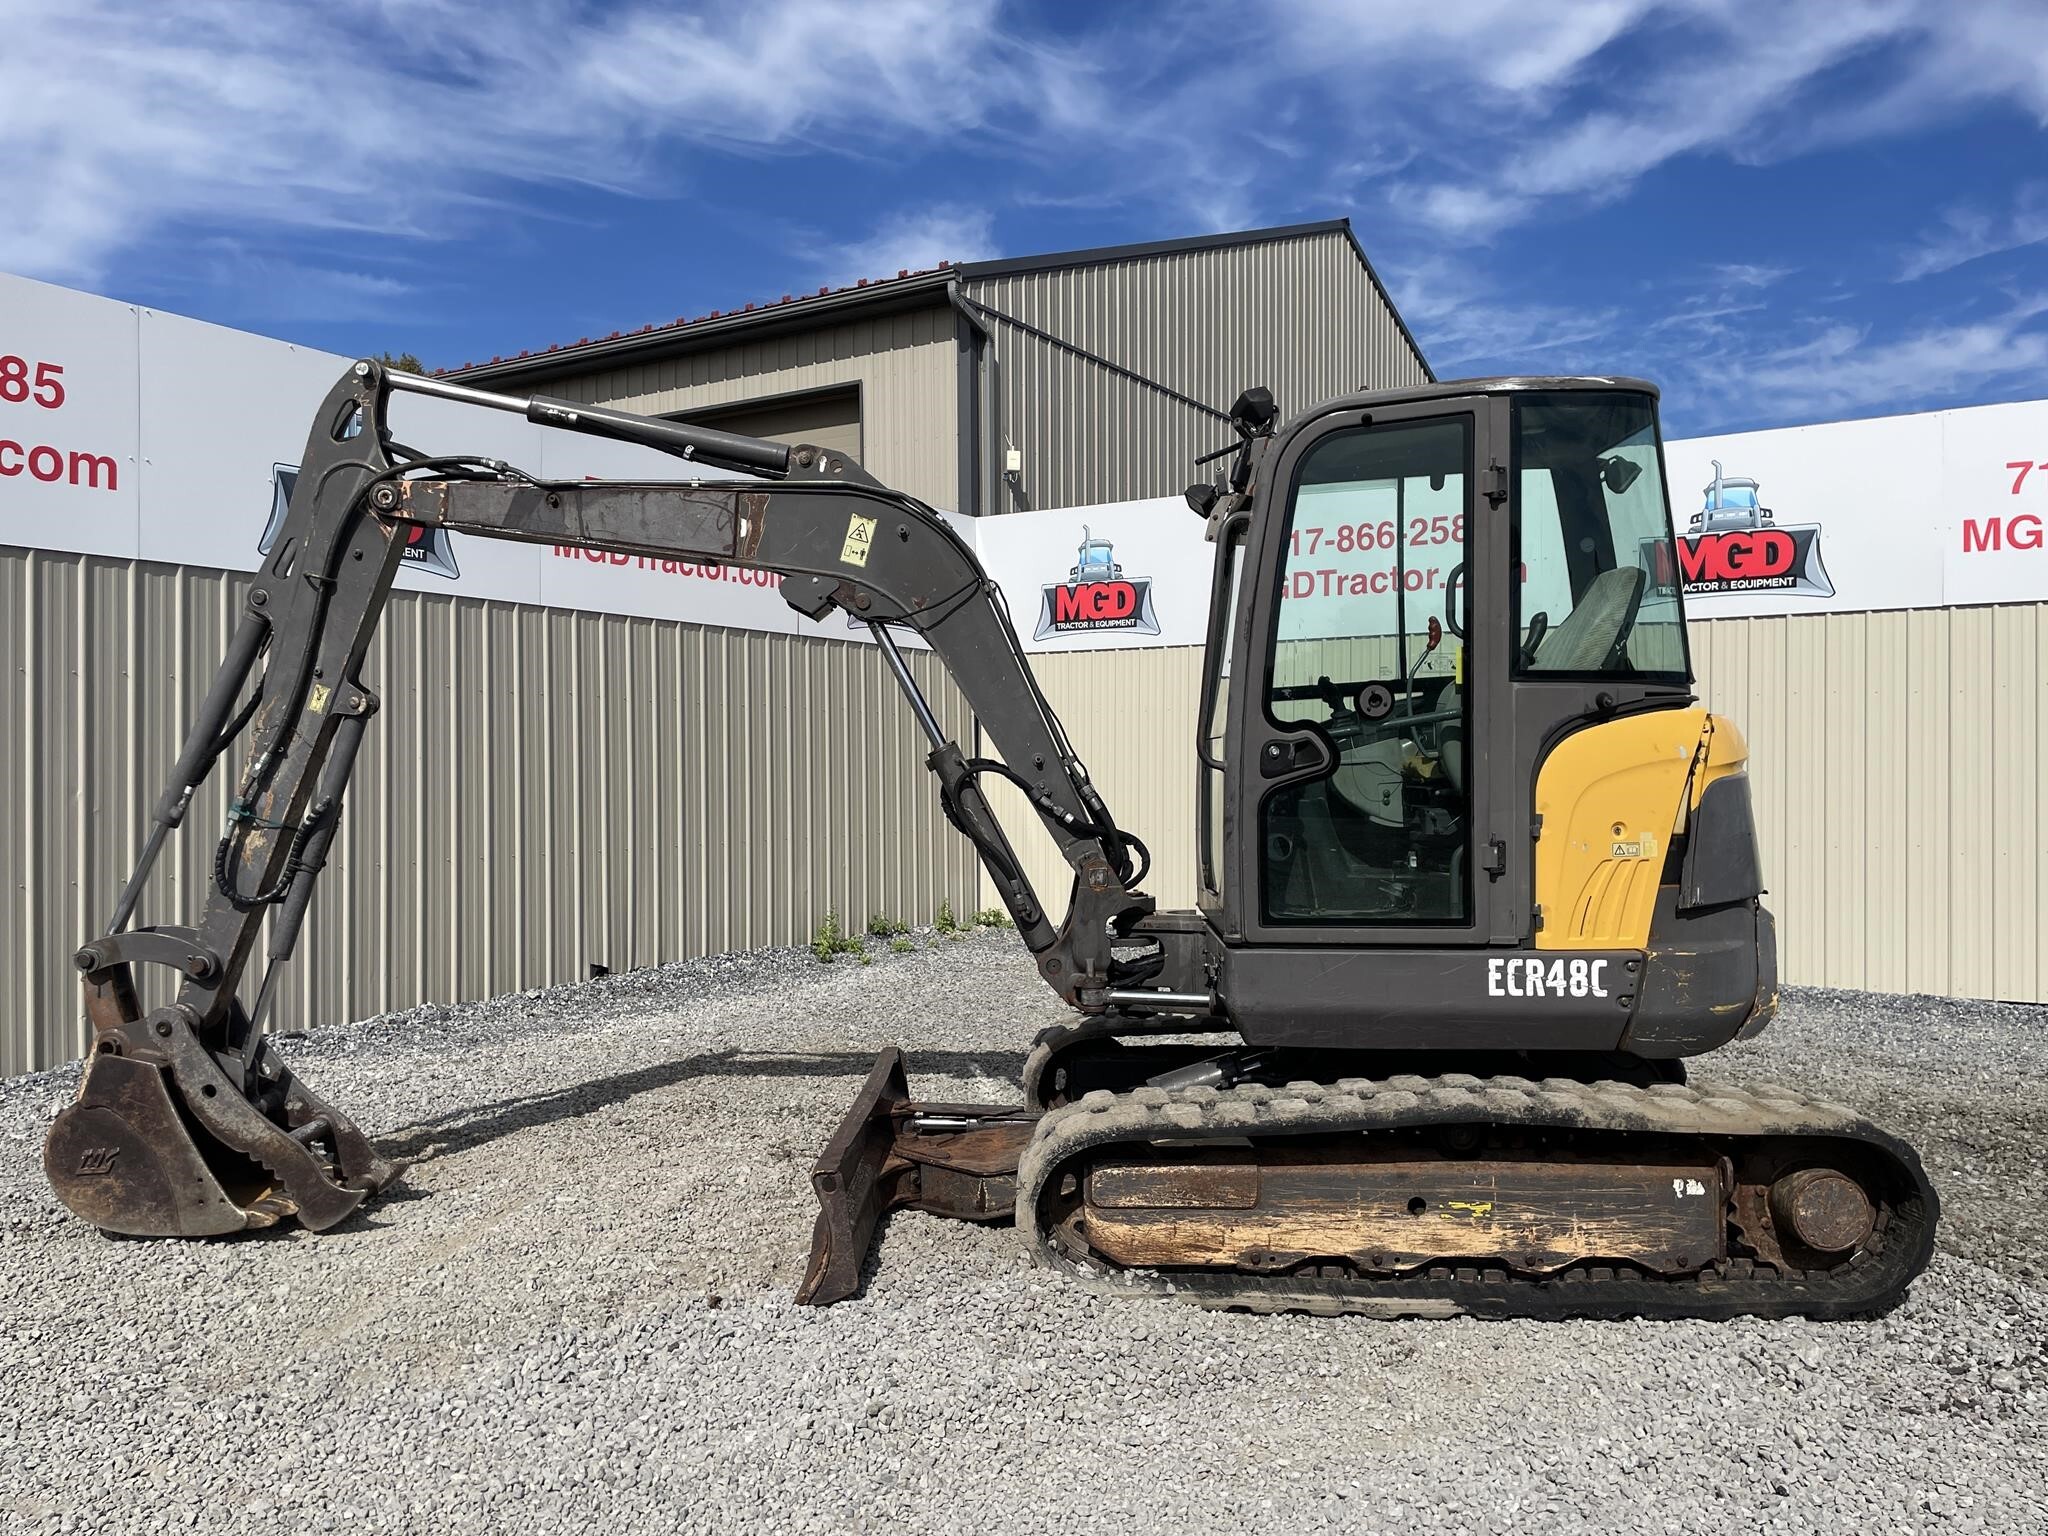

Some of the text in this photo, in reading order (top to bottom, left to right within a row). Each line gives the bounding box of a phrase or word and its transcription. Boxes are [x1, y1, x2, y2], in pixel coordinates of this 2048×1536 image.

[0, 355, 66, 409] 85
[402, 547, 425, 559] ENT
[1963, 514, 2043, 553] MG
[1656, 531, 1796, 581] MGD
[1056, 582, 1136, 621] MGD
[1730, 577, 1795, 590] EQUIPMENT
[1095, 619, 1135, 627] EQUIPMENT
[1487, 958, 1609, 998] ECR48C
